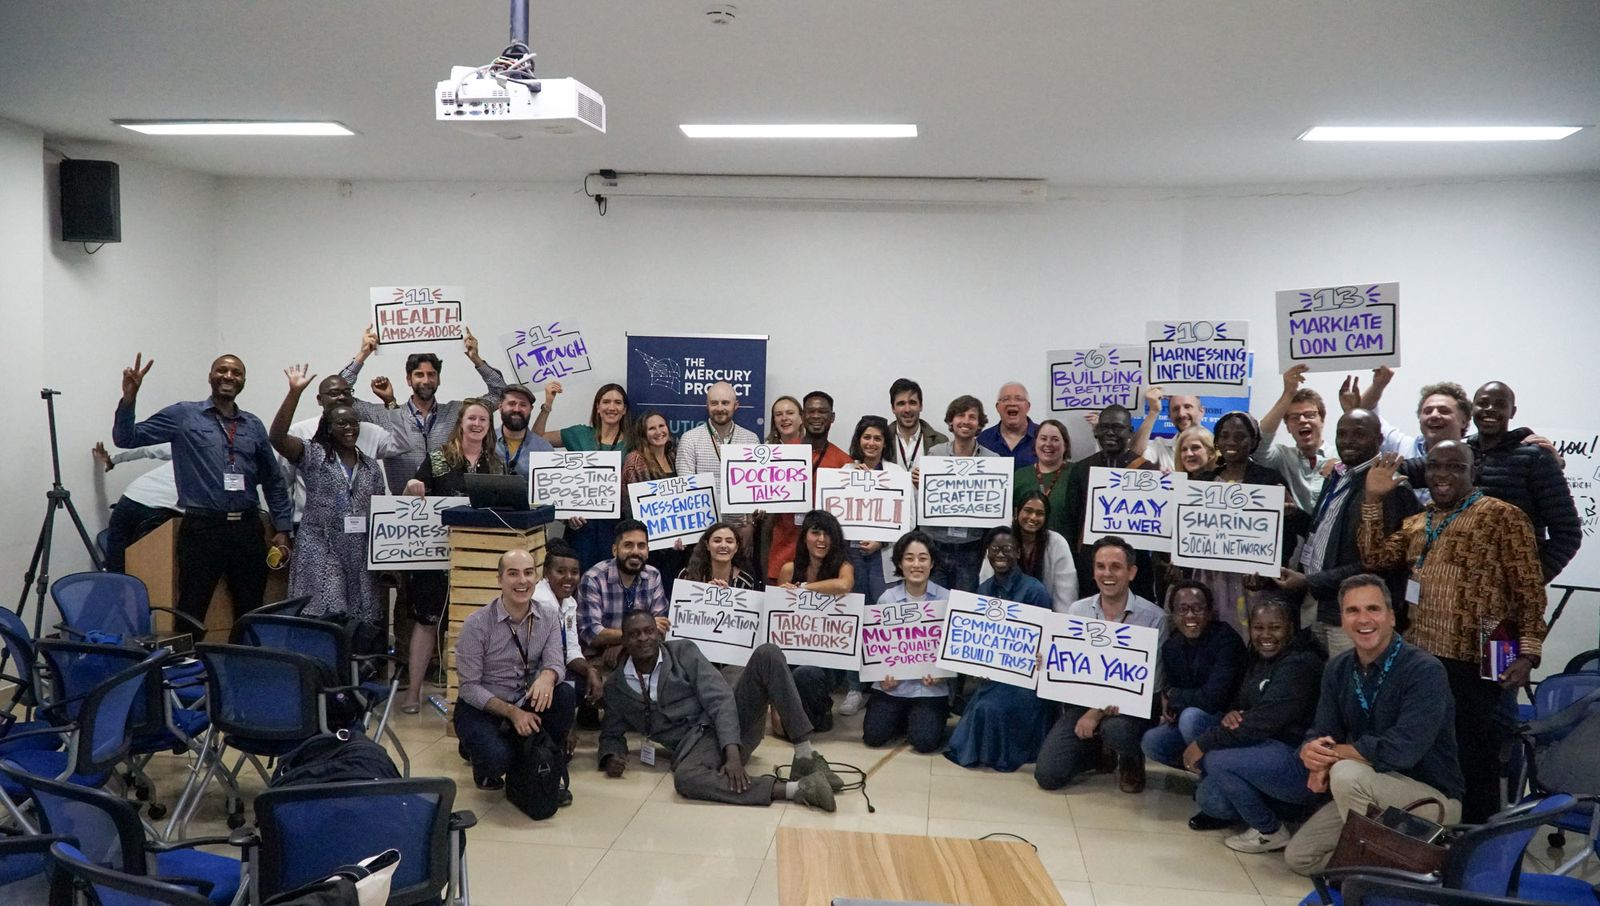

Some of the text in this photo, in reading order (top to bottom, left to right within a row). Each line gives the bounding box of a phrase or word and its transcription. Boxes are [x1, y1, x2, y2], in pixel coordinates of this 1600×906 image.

[405, 288, 434, 306] 11
[1313, 286, 1364, 311] 13
[380, 307, 460, 326] HEALTH
[1290, 313, 1382, 335] MARKLATE
[381, 325, 462, 340] AMBASSADORS
[529, 326, 553, 345] 1
[1177, 321, 1214, 344] 10
[515, 337, 588, 370] A TOUGH
[1300, 333, 1383, 355] DON CAM
[684, 358, 705, 367] THE
[1084, 350, 1105, 369] 6
[1152, 346, 1246, 362] HARNESSING
[532, 361, 574, 384] CALL
[684, 369, 752, 381] MERCURY
[1054, 369, 1142, 386] BUILDING
[1157, 363, 1246, 380] INFLUENCERS
[684, 382, 752, 396] PRCT
[1061, 384, 1131, 394] A BETTER
[1056, 394, 1131, 407] TOOLKIT
[565, 453, 583, 470] 5
[754, 445, 771, 465] 9
[537, 471, 618, 487] BOOSTING
[730, 466, 808, 485] DOCTORS
[851, 471, 875, 492] 4
[926, 478, 1006, 491] COMMUNITY
[1122, 471, 1158, 491] 18
[538, 485, 616, 500] BOOSTERS
[658, 477, 688, 496] 14
[746, 485, 790, 501] TALKS
[571, 499, 608, 507] SCALE
[639, 494, 711, 518] MESSENGER
[927, 491, 1000, 504] CRAFTED
[1099, 495, 1168, 517] YAAY
[1205, 484, 1248, 509] 16
[411, 497, 428, 520] 2
[825, 496, 904, 525] BIMLI
[930, 503, 1001, 514] MESSAGES
[647, 511, 716, 536] MATTERS
[1103, 517, 1162, 534] JU WER
[1182, 512, 1268, 532] SHARING
[1215, 529, 1226, 540] in
[1181, 536, 1274, 557] SOCIAL NETWORKS
[705, 586, 733, 607] 12
[798, 590, 836, 611] 17
[882, 603, 922, 626] 15
[985, 599, 1005, 621] 8
[773, 614, 853, 637] TARGETING
[862, 625, 942, 644] MUTING
[952, 615, 1039, 642] COMMUNITY
[1086, 621, 1112, 647] 3
[771, 631, 849, 649] NETWORKS
[951, 629, 1036, 657] EDUCATION
[884, 653, 938, 667] SOURCES
[950, 645, 1035, 672] to BUILD TRUST
[1046, 643, 1148, 682] AFYA YAKO
